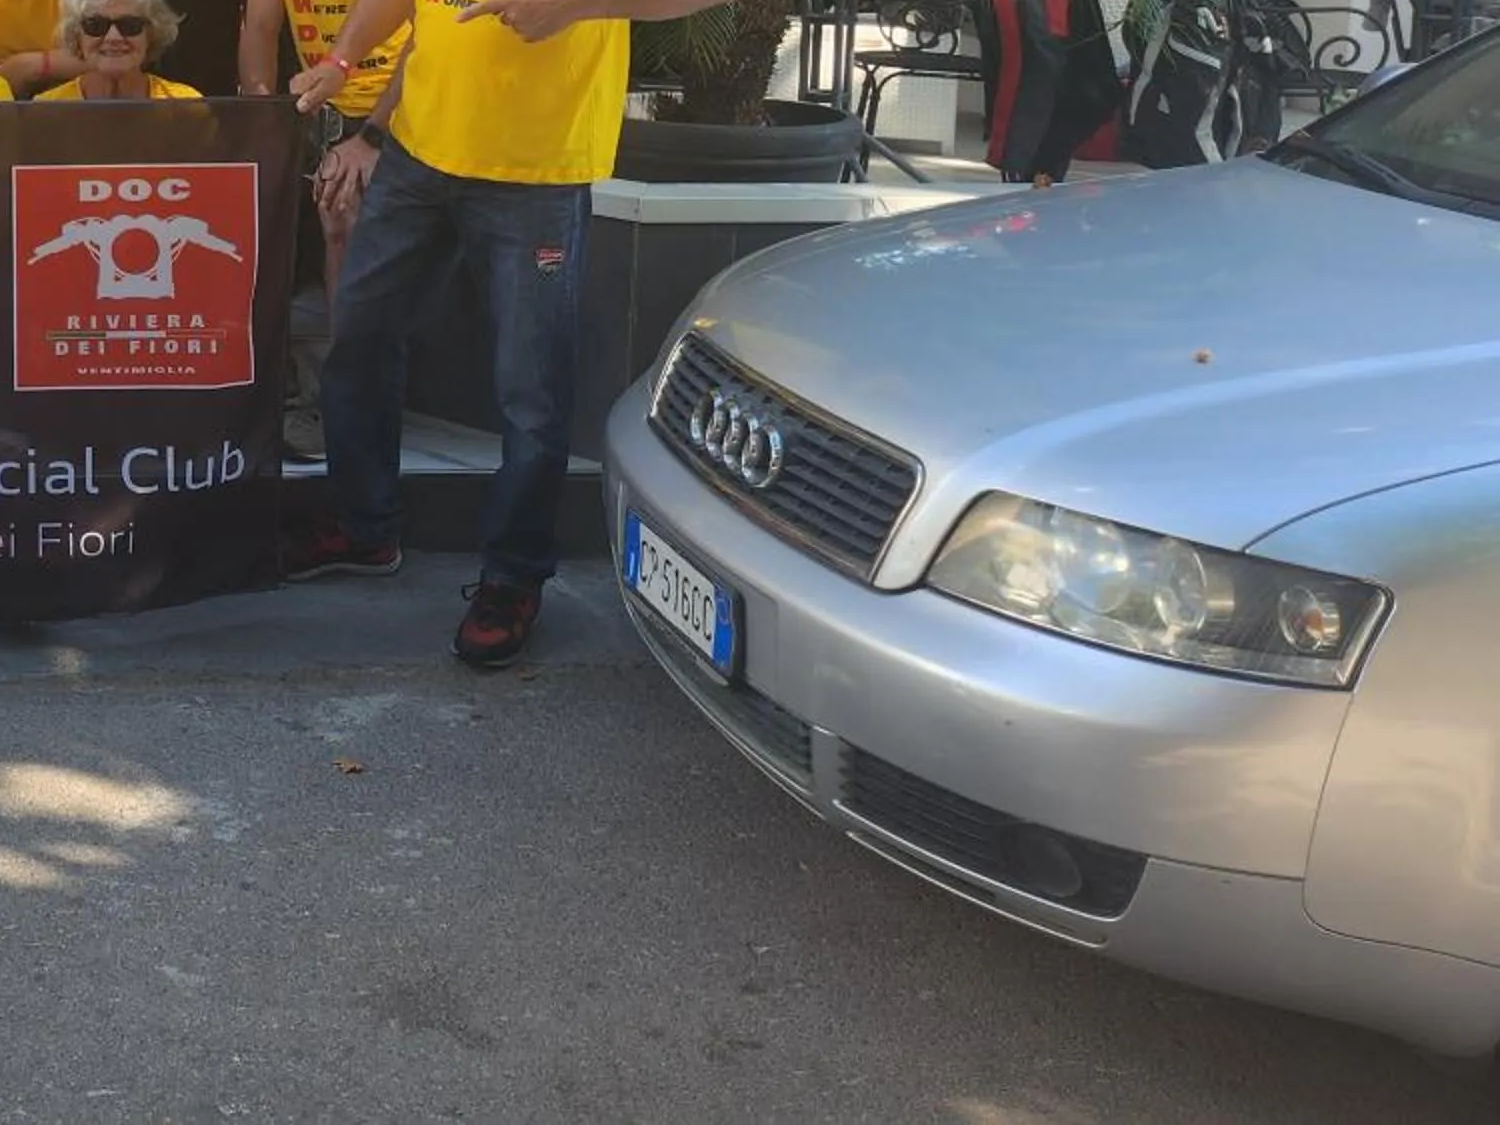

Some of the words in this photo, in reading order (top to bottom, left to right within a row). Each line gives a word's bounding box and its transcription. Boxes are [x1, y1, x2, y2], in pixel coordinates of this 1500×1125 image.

[79, 179, 192, 202] DOC
[67, 314, 206, 330] RIVIERA
[55, 340, 105, 356] DEI
[129, 339, 217, 355] FIORI
[121, 440, 246, 494] Club
[38, 522, 135, 558] Fiori
